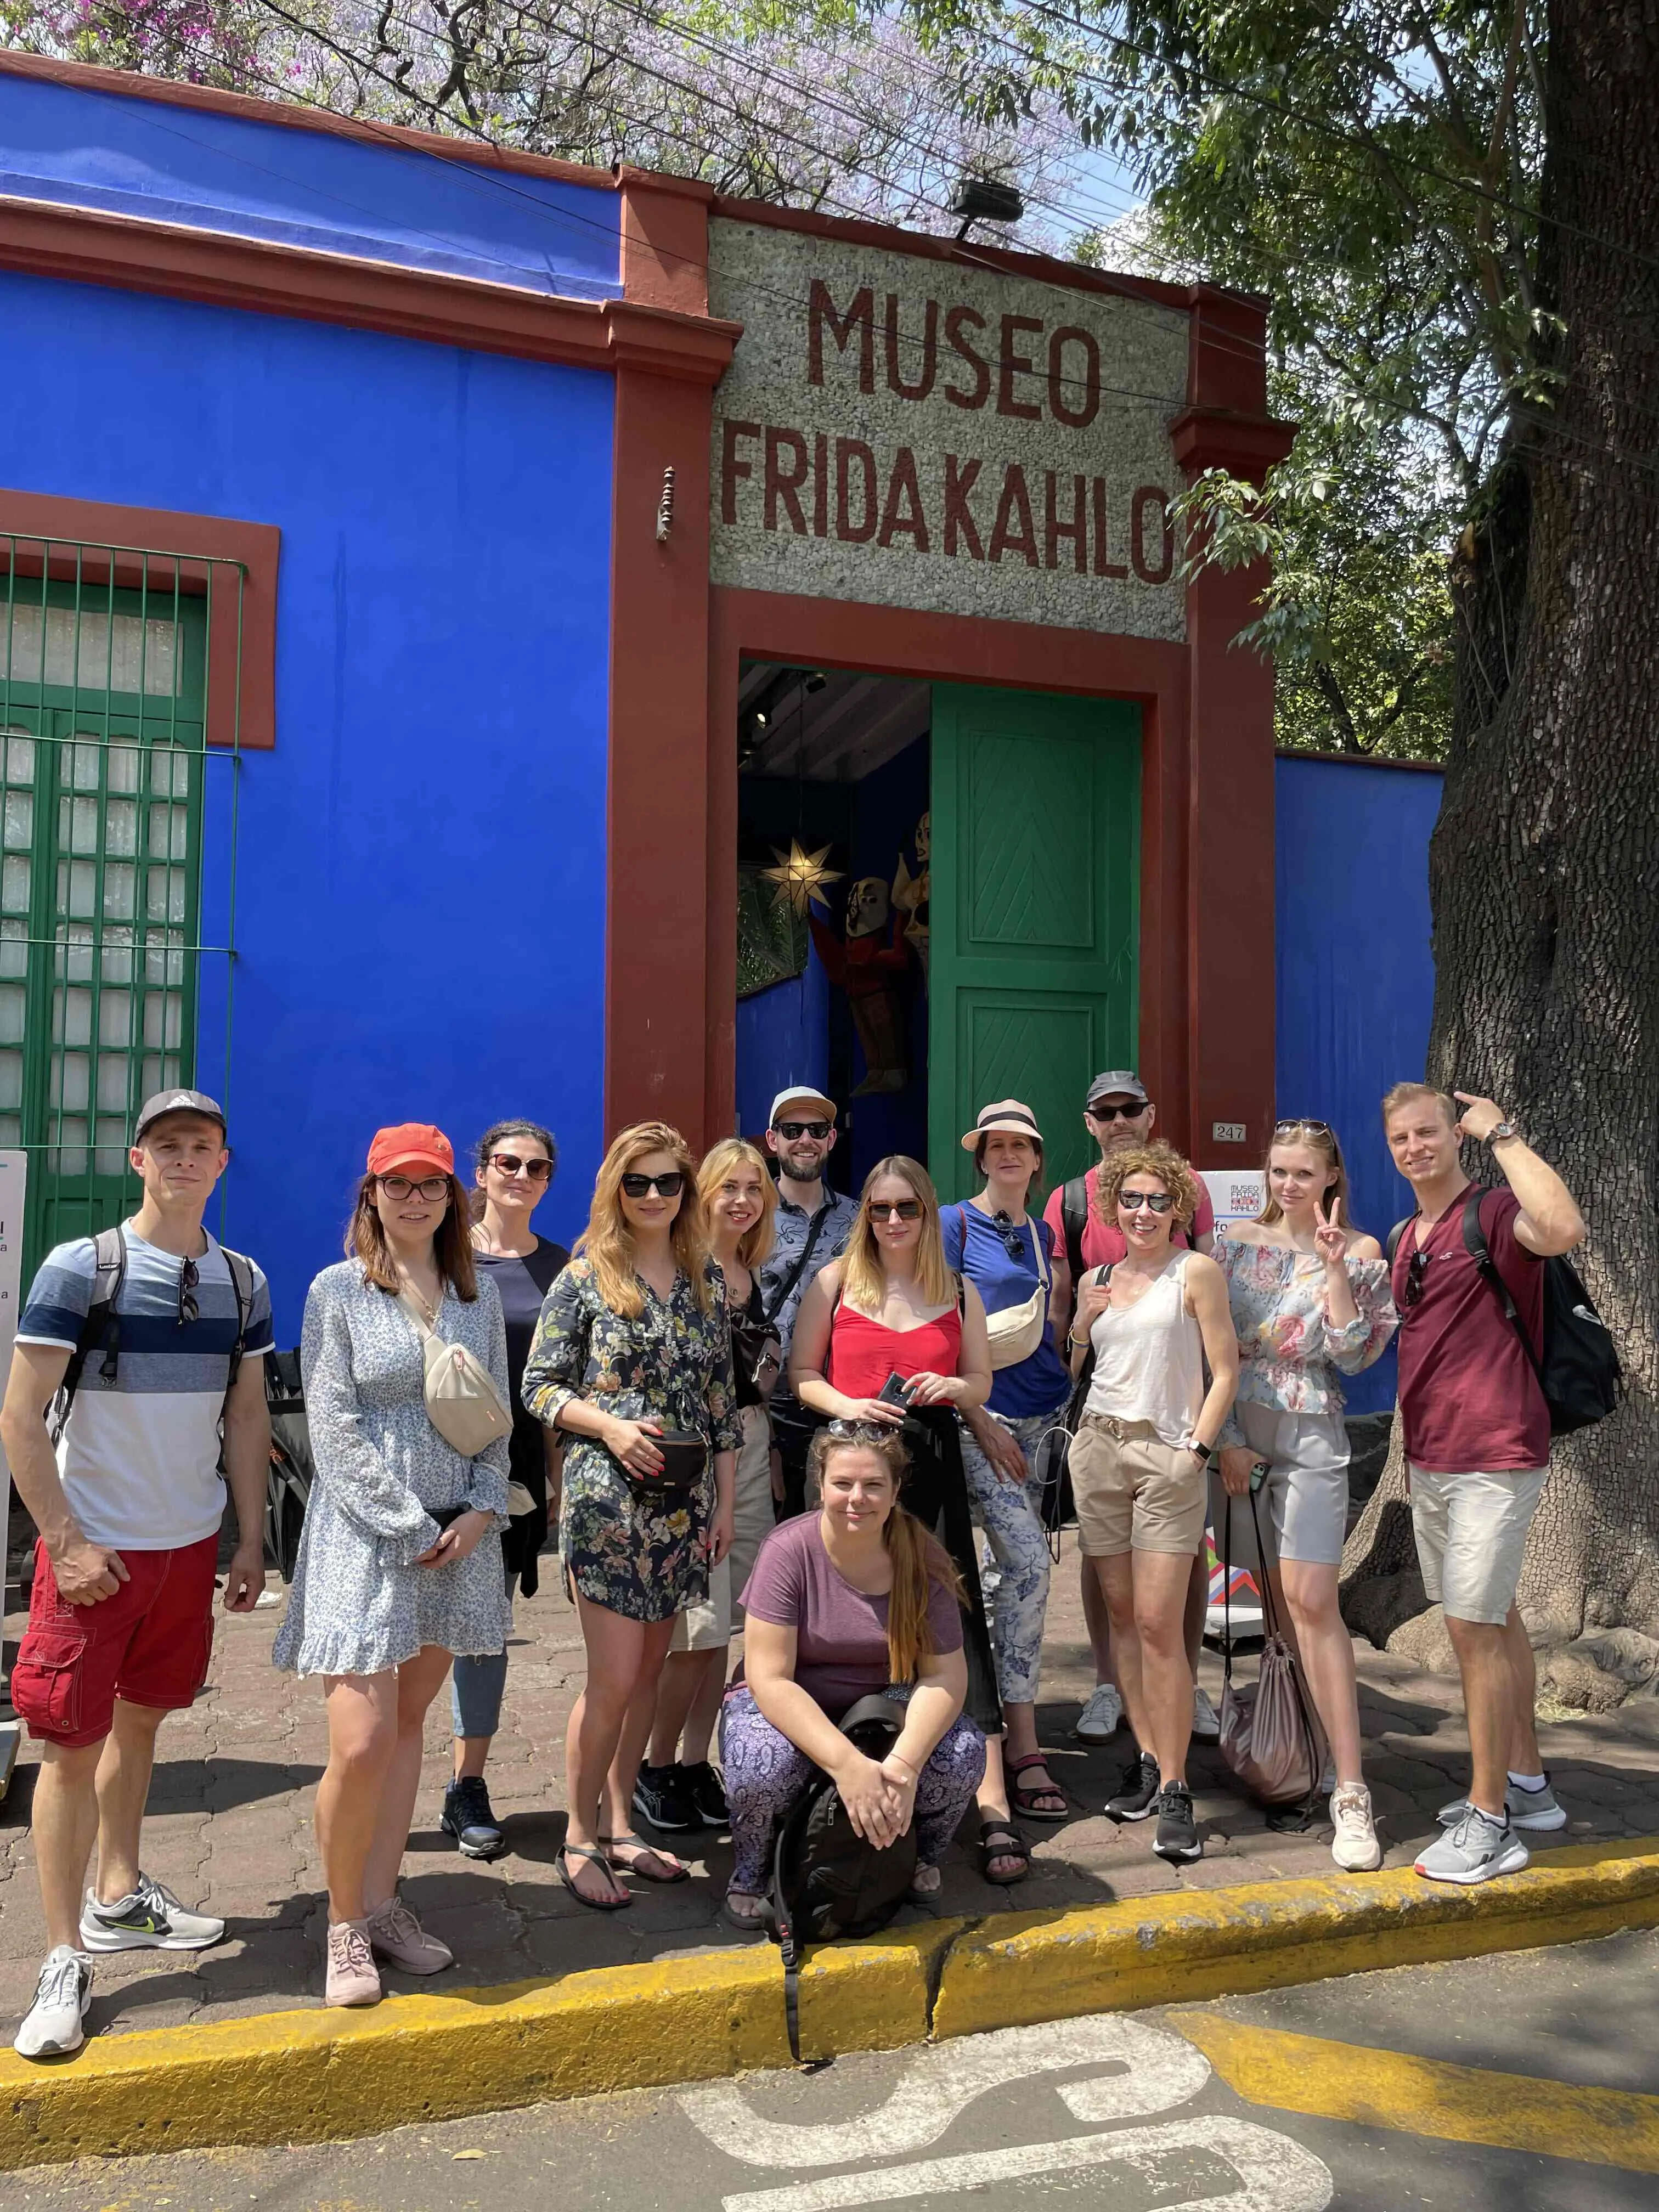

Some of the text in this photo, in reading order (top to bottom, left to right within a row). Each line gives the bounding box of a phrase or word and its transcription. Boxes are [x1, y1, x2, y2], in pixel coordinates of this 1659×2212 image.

[808, 279, 1101, 428] MUSEO
[721, 420, 1175, 584] FRIDA KAHLO
[1217, 1126, 1243, 1139] 247
